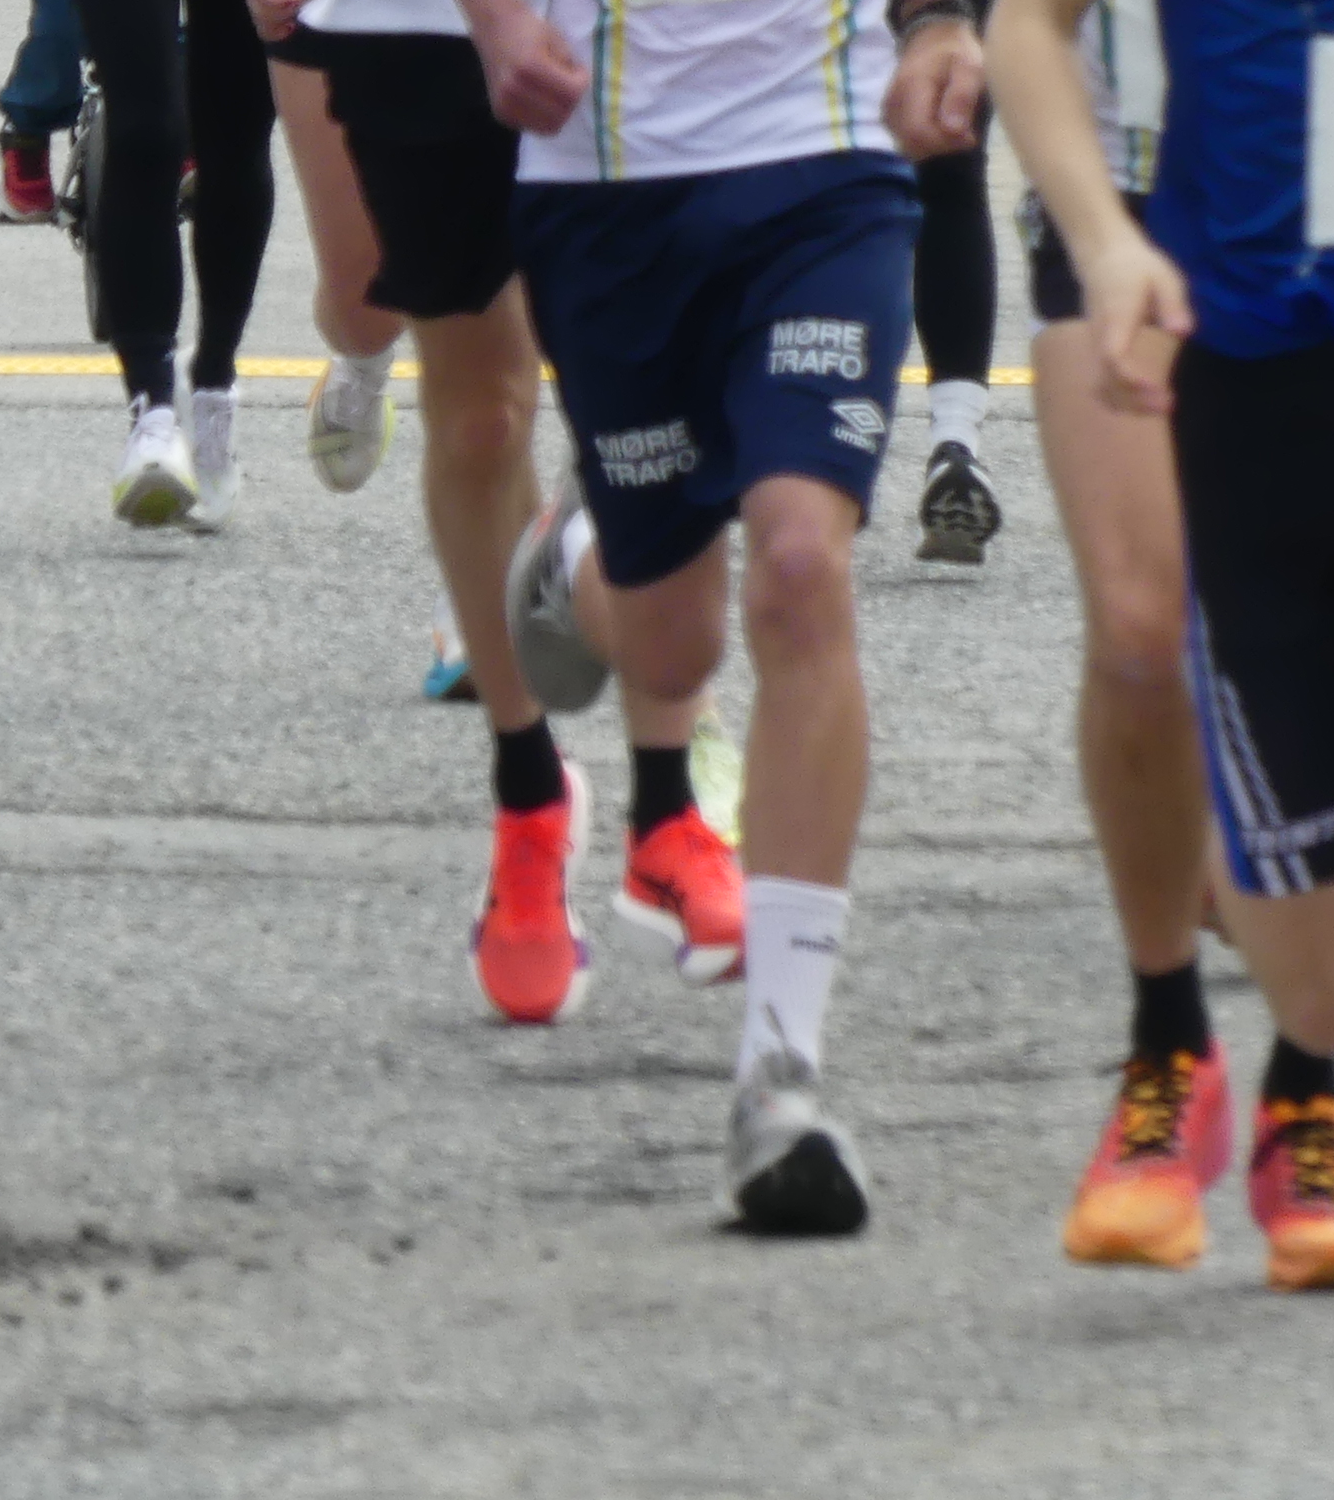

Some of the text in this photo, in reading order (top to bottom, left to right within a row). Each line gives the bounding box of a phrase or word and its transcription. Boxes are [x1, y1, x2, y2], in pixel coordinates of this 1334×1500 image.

[771, 319, 866, 350] MØRE
[769, 350, 863, 379] TRAFO
[594, 419, 689, 460] MØRE
[601, 448, 697, 487] TRAFO
